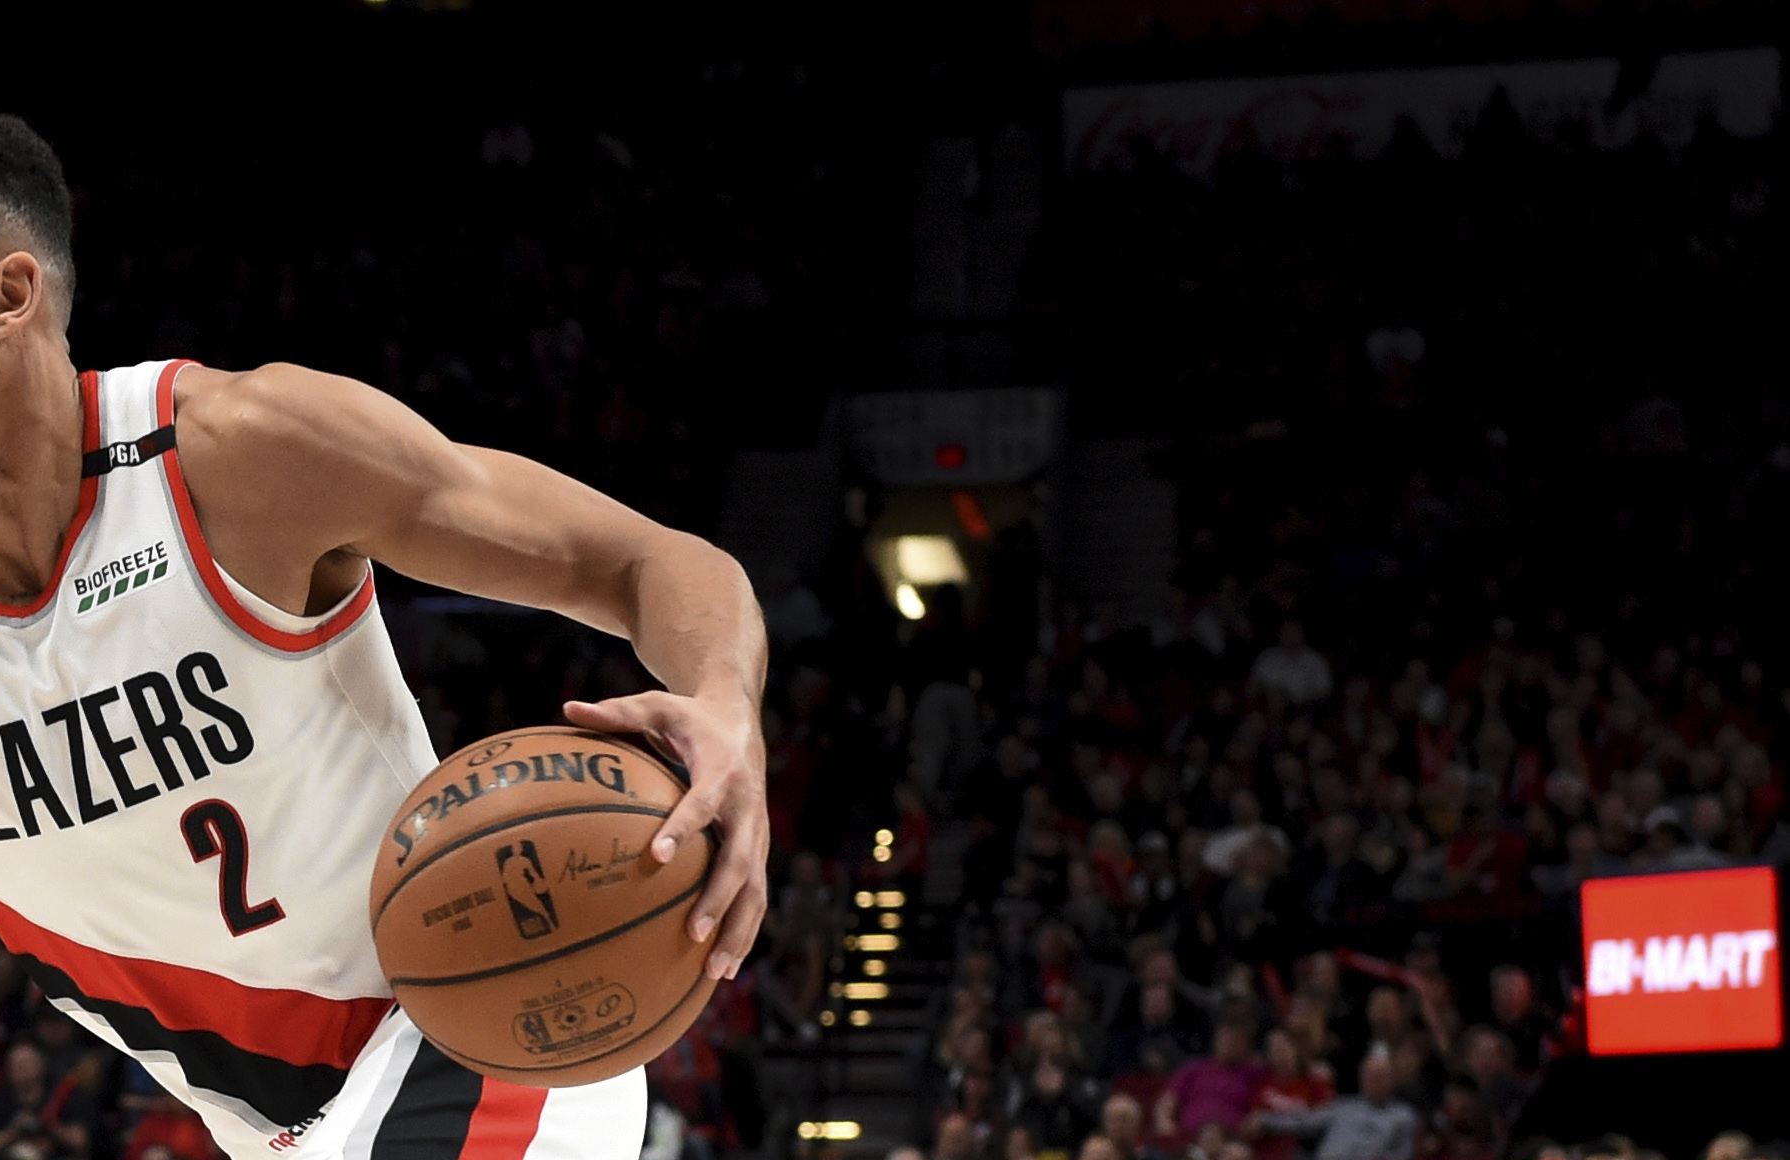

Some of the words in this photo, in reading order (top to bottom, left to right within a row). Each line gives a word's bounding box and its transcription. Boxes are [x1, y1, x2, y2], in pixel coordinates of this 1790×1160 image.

[108, 443, 140, 468] PGA
[74, 540, 168, 596] BIOFREEZE
[393, 751, 626, 867] SPALDING
[179, 798, 286, 937] 2
[1588, 929, 1777, 997] BI-MART
